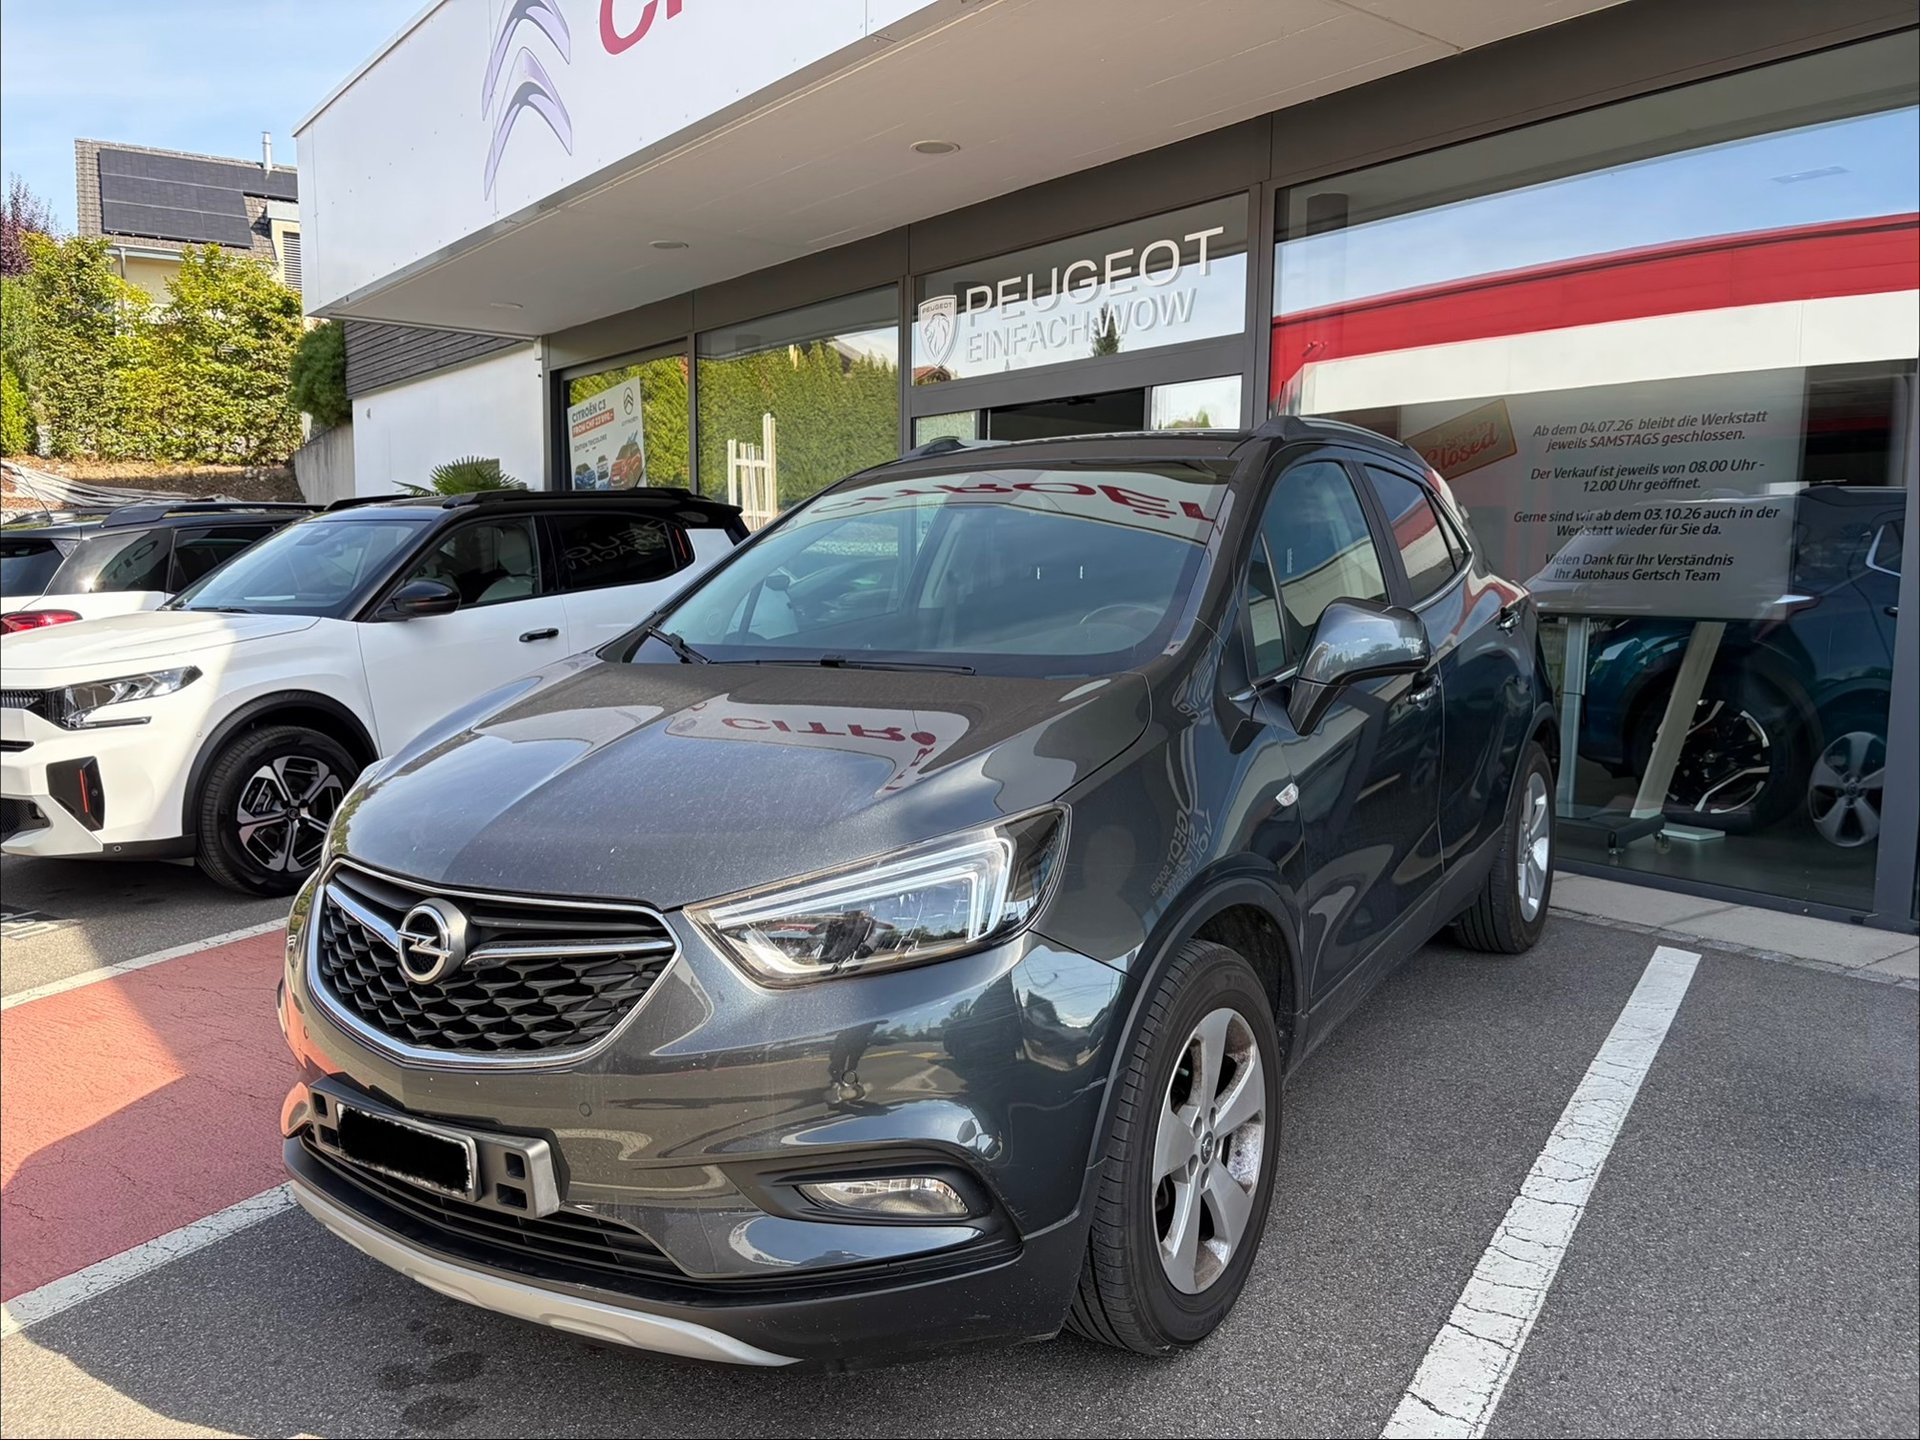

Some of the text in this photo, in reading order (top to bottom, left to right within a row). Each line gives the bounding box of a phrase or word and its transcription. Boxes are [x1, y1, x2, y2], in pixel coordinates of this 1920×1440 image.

[966, 226, 1224, 324] PEUGEOT
[922, 302, 953, 314] PEUGEOT
[967, 287, 1197, 363] EINFACH WOW
[1533, 410, 1768, 437] Ab dem 04.07.26 bleibt die Werkstatt
[1546, 429, 1745, 452] jeweils SAMSTAGS geschlossen.
[1531, 468, 1551, 480] Der
[1554, 464, 1599, 479] Verkauf
[1599, 464, 1614, 477] ist
[1614, 462, 1659, 480] jeweils
[1662, 464, 1685, 475] von
[1688, 460, 1728, 474] 08.00
[1731, 459, 1757, 472] Uhr
[1583, 477, 1702, 494] 12.00 Uhr geöffnet.
[1514, 507, 1780, 523] Gerne sind wir ab dem 03.10.26 auch in der
[1556, 523, 1722, 537] Werkstatt wieder für Sie da.
[1545, 553, 1734, 567] Vielen Dank für Ihr Verständnis
[1554, 568, 1721, 582] Ihr Autohaus Gertsch Team
